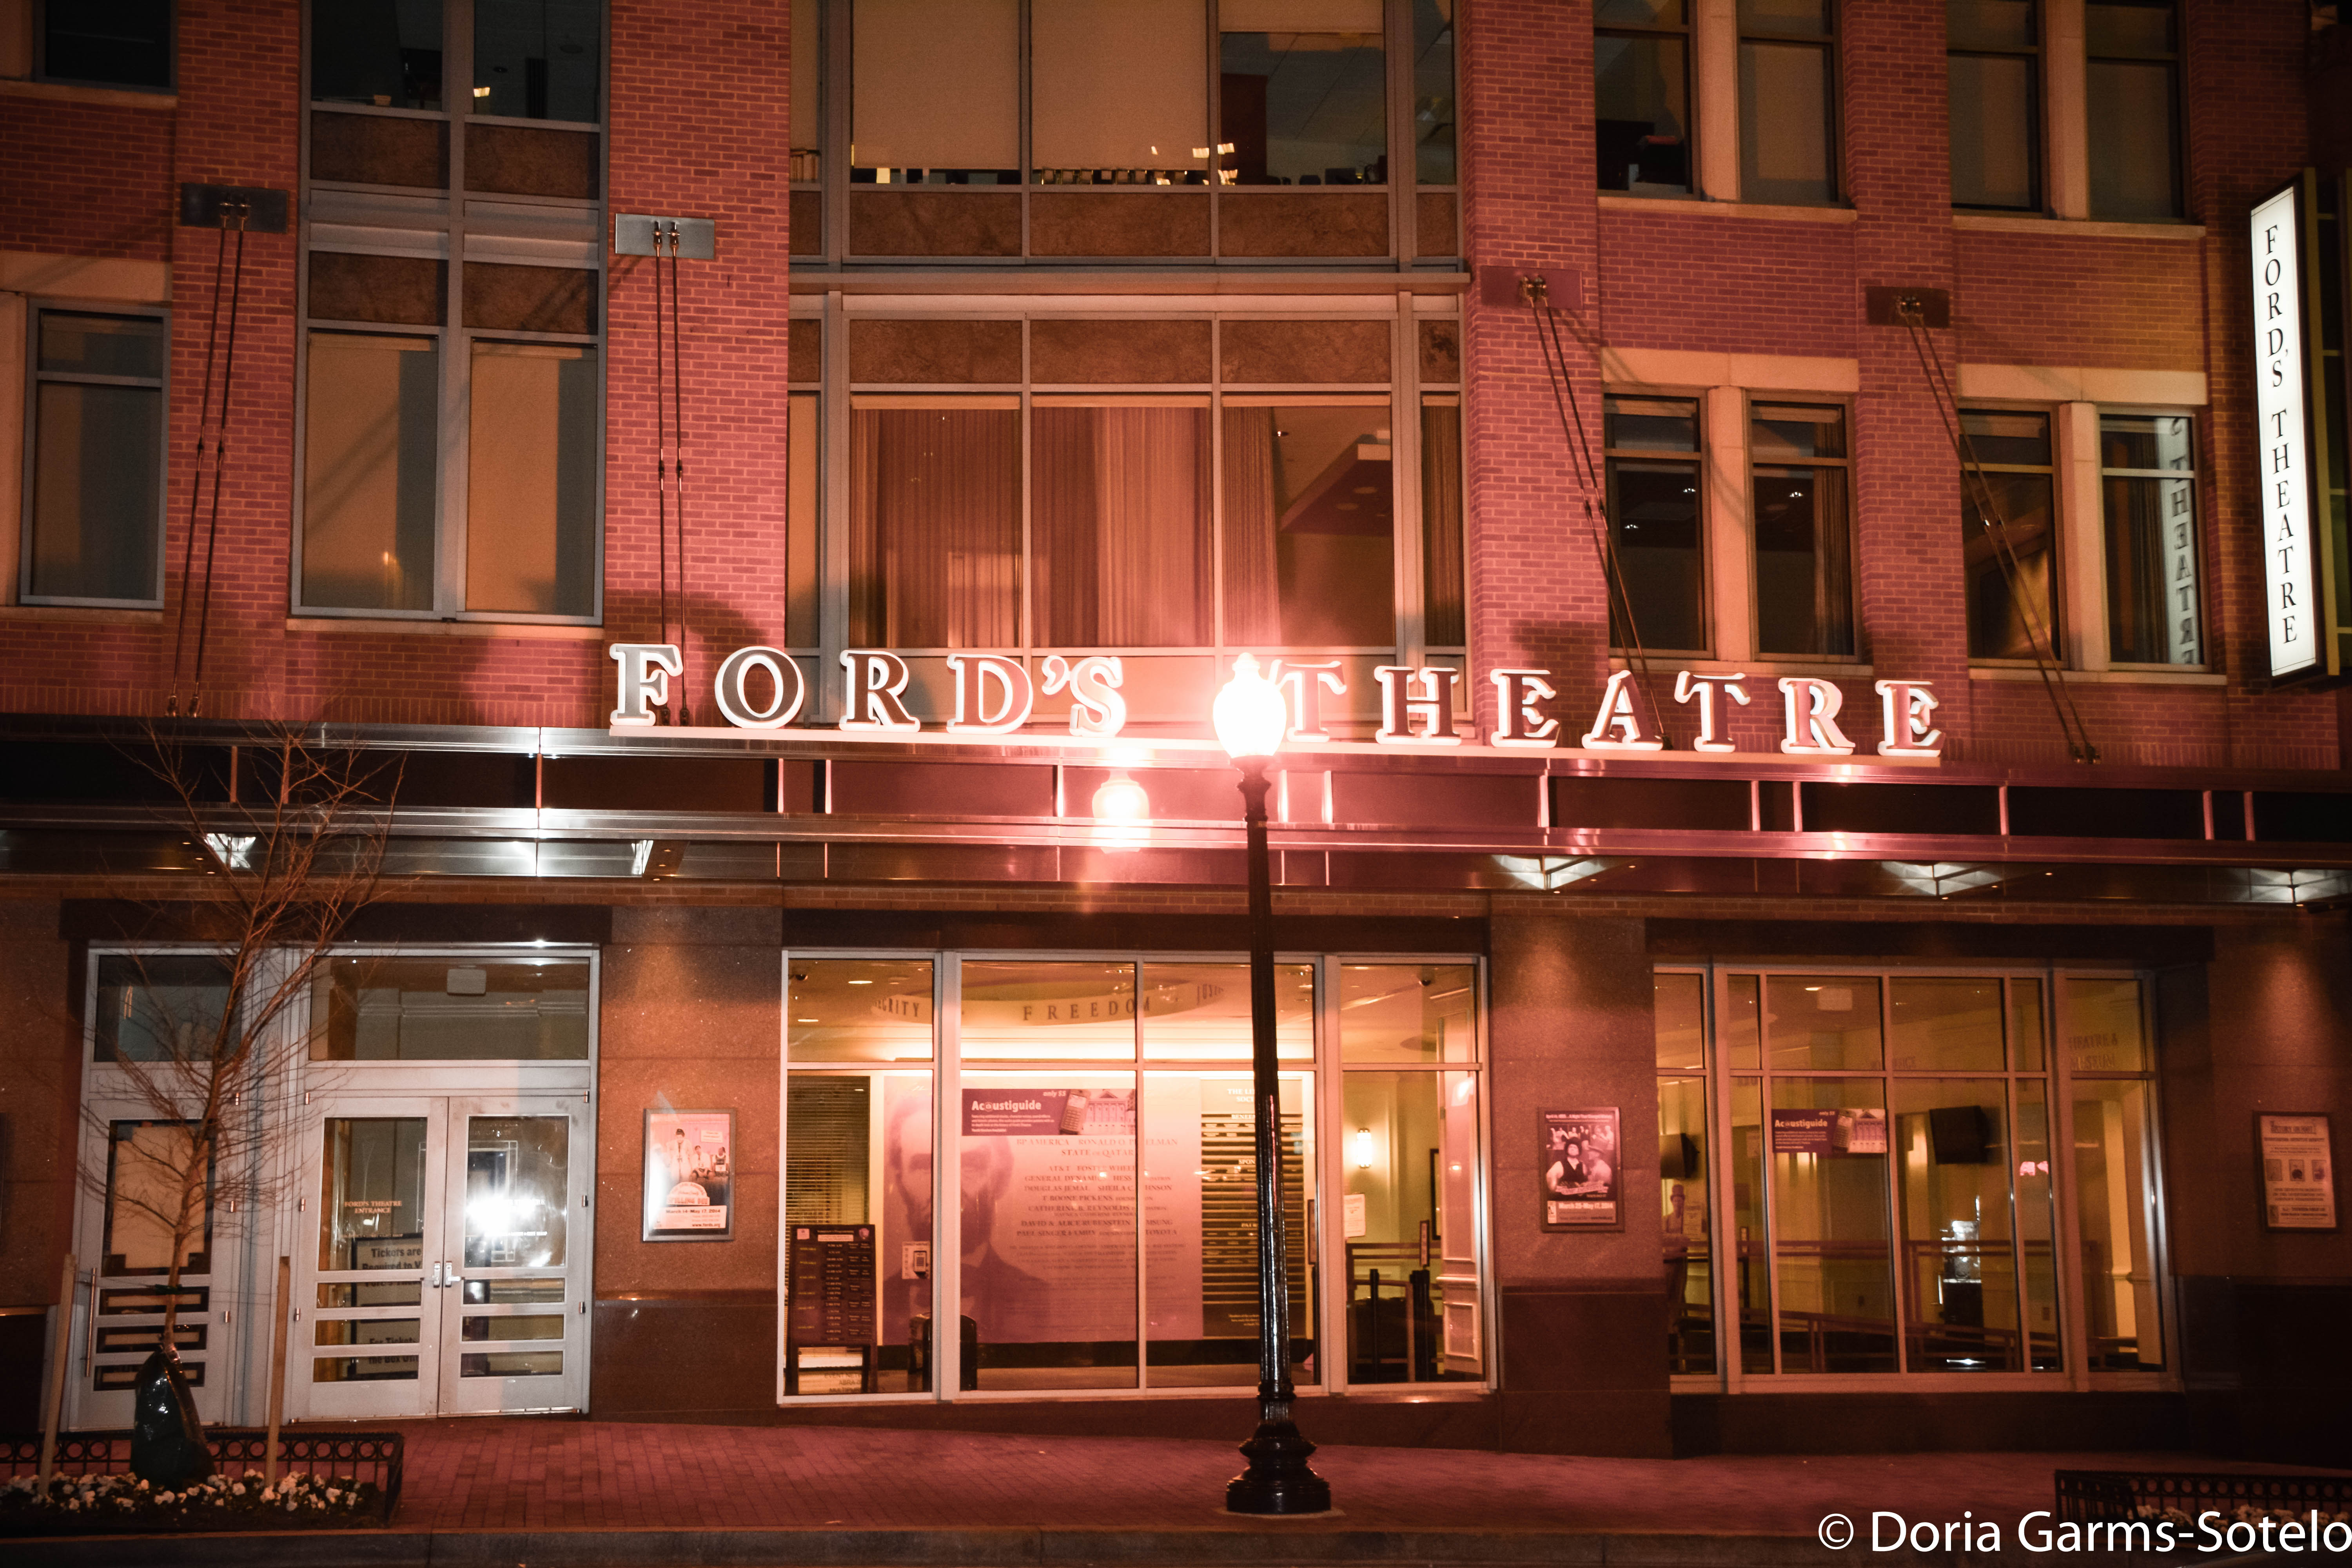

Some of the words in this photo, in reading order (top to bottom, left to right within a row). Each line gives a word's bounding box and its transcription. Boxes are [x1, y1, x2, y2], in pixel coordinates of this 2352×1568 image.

[2264, 224, 2289, 389] FORD'S
[2271, 408, 2298, 645] THEATRE
[610, 643, 1126, 737] FORD'S
[1269, 655, 1945, 758] THEATRE
[971, 1099, 1042, 1112] Acoustiguide
[1775, 1118, 1828, 1129] Acoustiguide
[1102, 1149, 1134, 1158] QATAR
[371, 1248, 405, 1258] Tickets
[362, 1261, 401, 1270] Required
